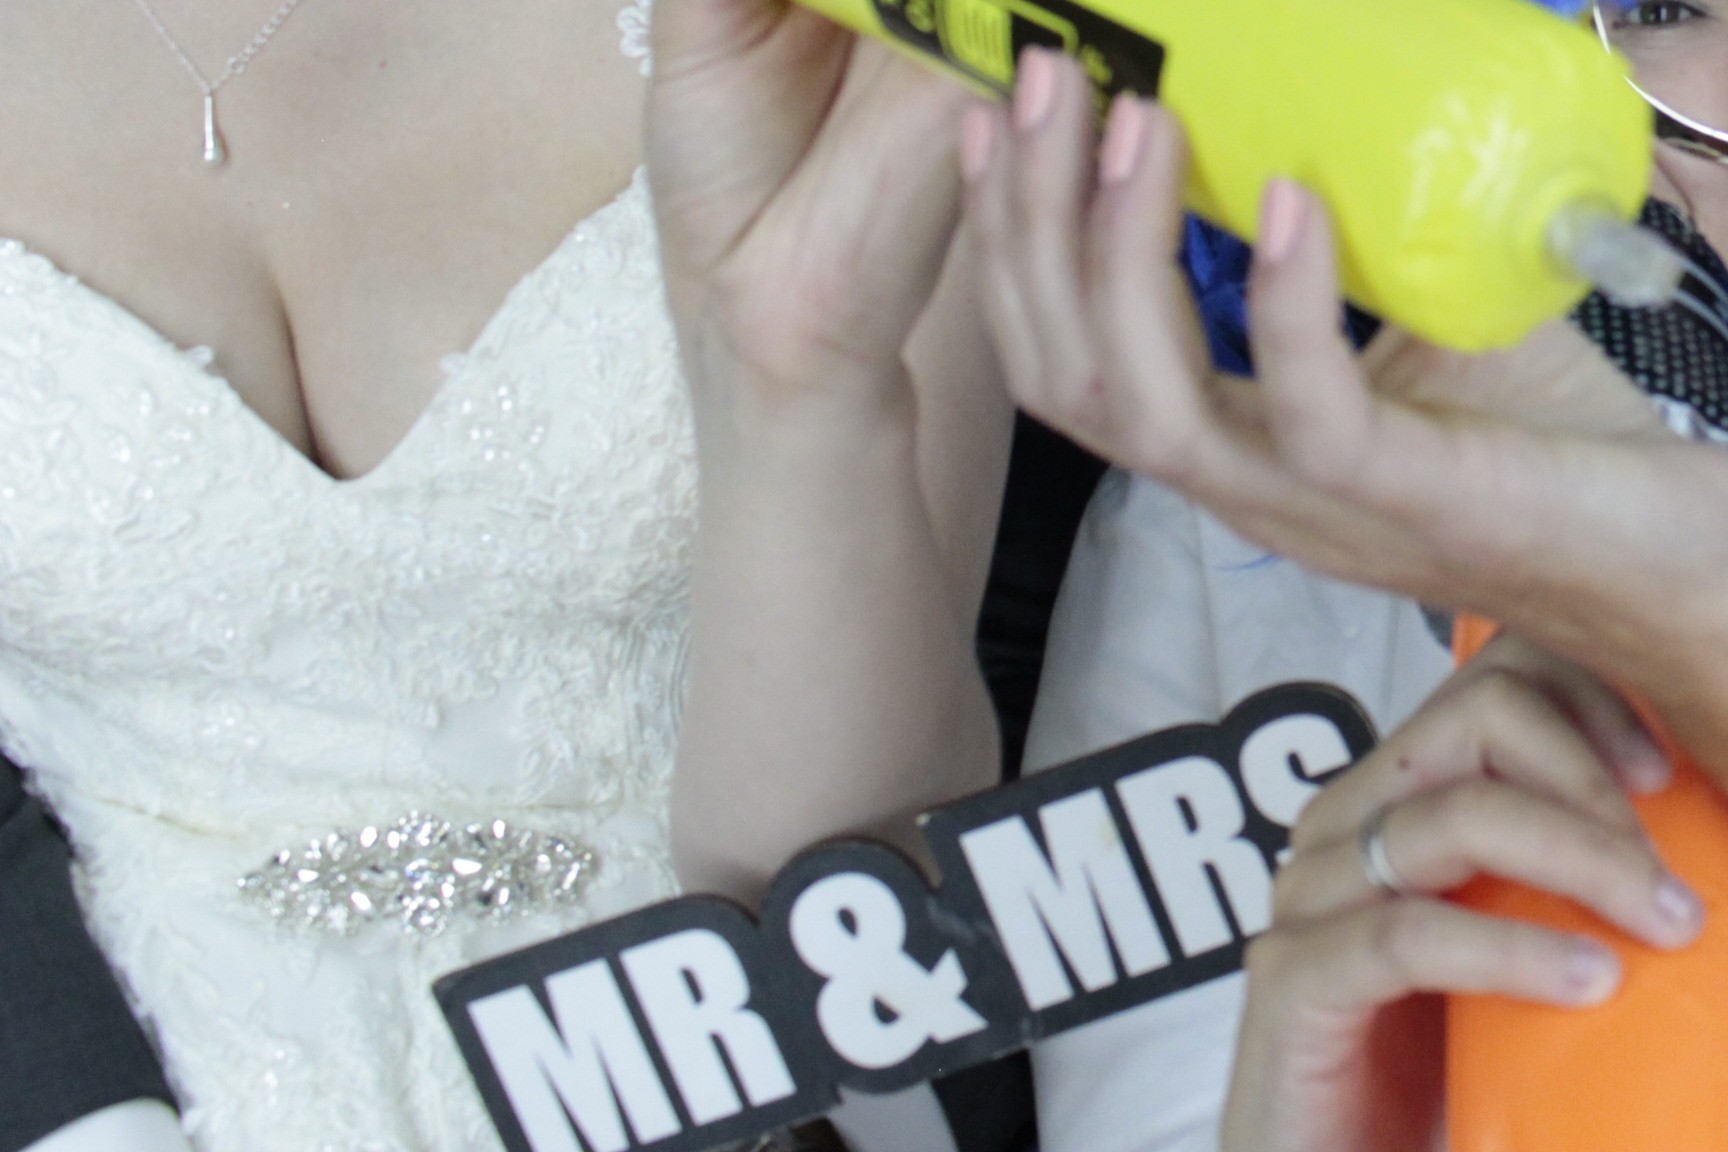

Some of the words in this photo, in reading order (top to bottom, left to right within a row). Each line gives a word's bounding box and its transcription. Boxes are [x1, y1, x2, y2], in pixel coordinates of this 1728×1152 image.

[466, 927, 798, 1152] MR
[788, 871, 989, 1070] &
[959, 712, 1353, 1012] MRS
